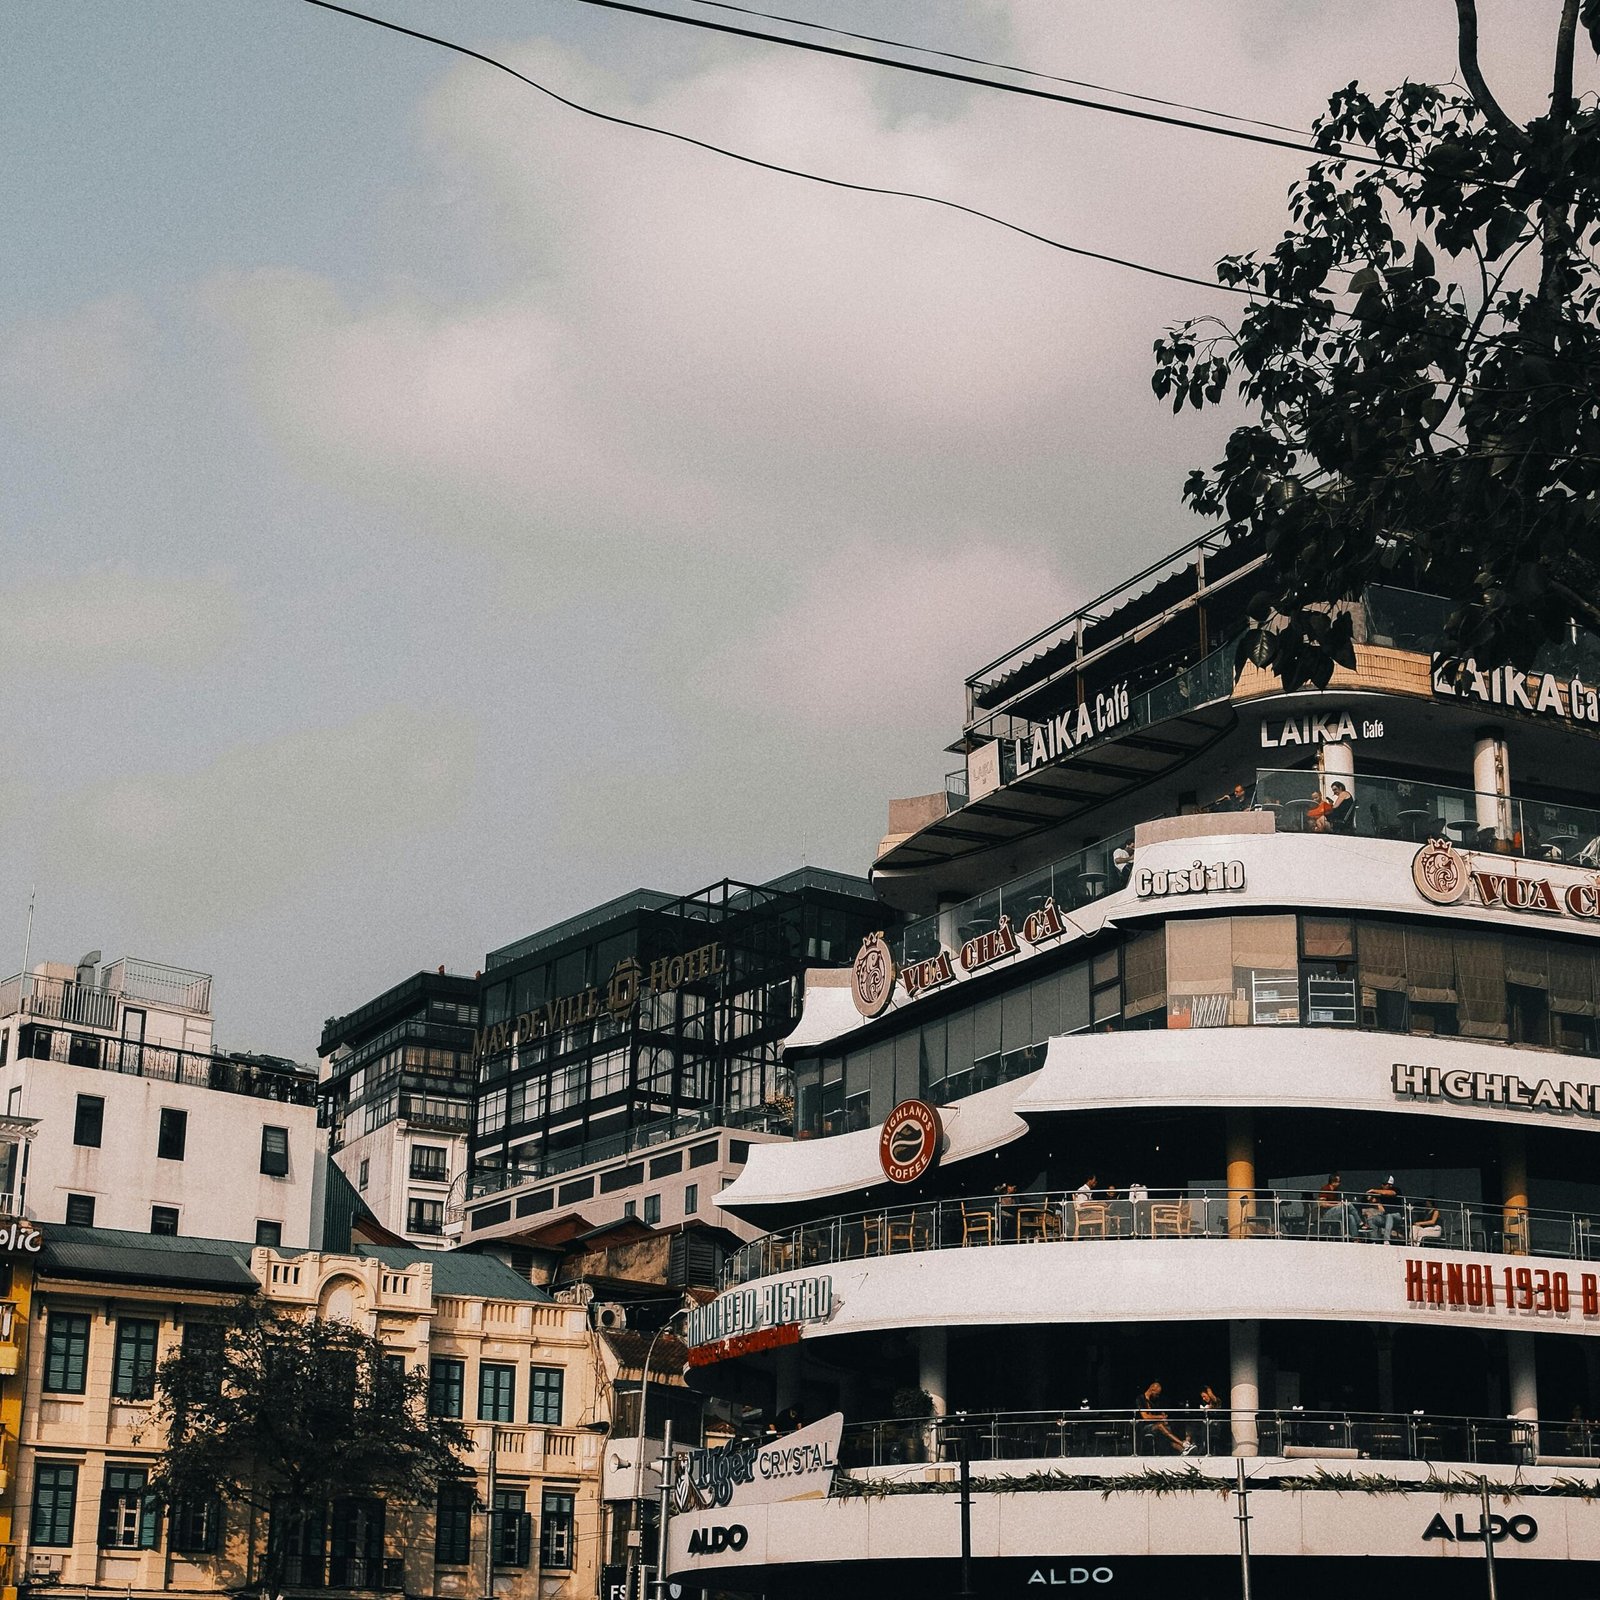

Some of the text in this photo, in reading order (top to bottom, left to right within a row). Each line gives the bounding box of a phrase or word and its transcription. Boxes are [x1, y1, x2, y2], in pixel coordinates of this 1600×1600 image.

[1571, 679, 1600, 722] Ca
[1015, 679, 1129, 776] LAIKA Café
[1260, 711, 1384, 748] LAIKA Café
[1135, 868, 1170, 898] Cơ
[1212, 860, 1245, 890] 10
[1471, 871, 1600, 918] VUA C
[901, 897, 1067, 997] VUA CHẢ CÁ
[472, 941, 725, 1062] MAY DE VILLE HOTEL
[882, 1105, 933, 1146] HIGHLANDS
[889, 1153, 928, 1179] COFFEE
[1405, 1259, 1495, 1308] HANOI
[1503, 1266, 1570, 1314] 1930
[687, 1275, 832, 1348] HANOI 1930 BISTRO
[759, 1442, 834, 1477] CRYSTAL
[688, 1523, 749, 1554] ALDO
[1421, 1512, 1538, 1542] ALDO
[1027, 1567, 1113, 1584] ALDO
